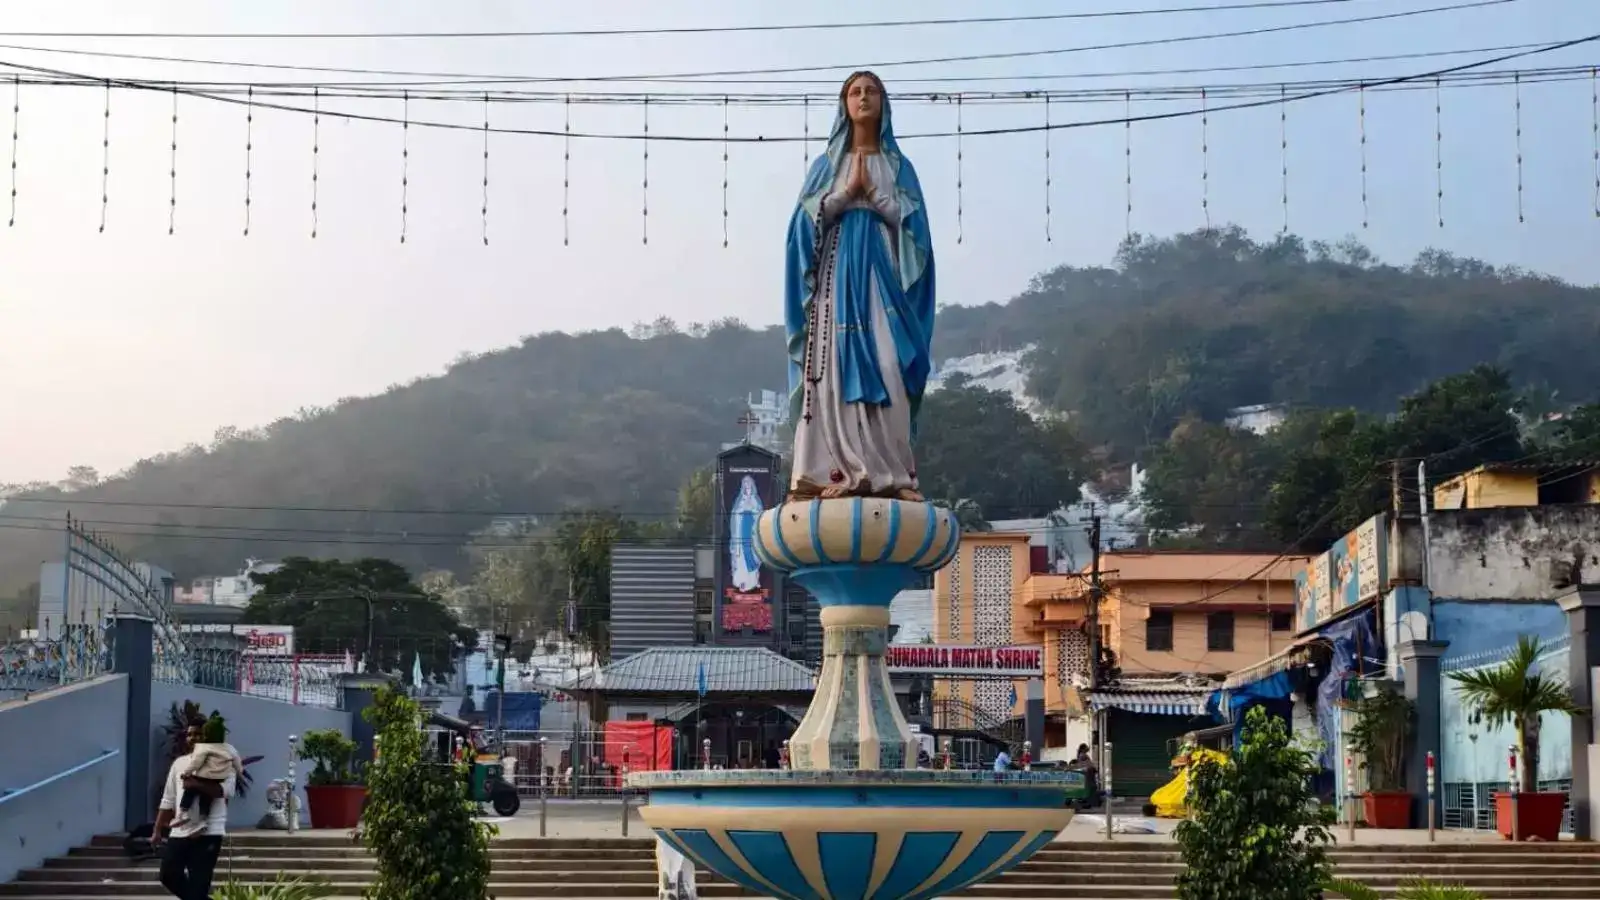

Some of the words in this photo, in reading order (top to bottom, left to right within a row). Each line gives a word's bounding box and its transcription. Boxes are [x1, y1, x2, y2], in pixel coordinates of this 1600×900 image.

[886, 647, 948, 668] GUNADALA
[951, 648, 993, 669] MATHA
[995, 648, 1041, 670] SHRINE
